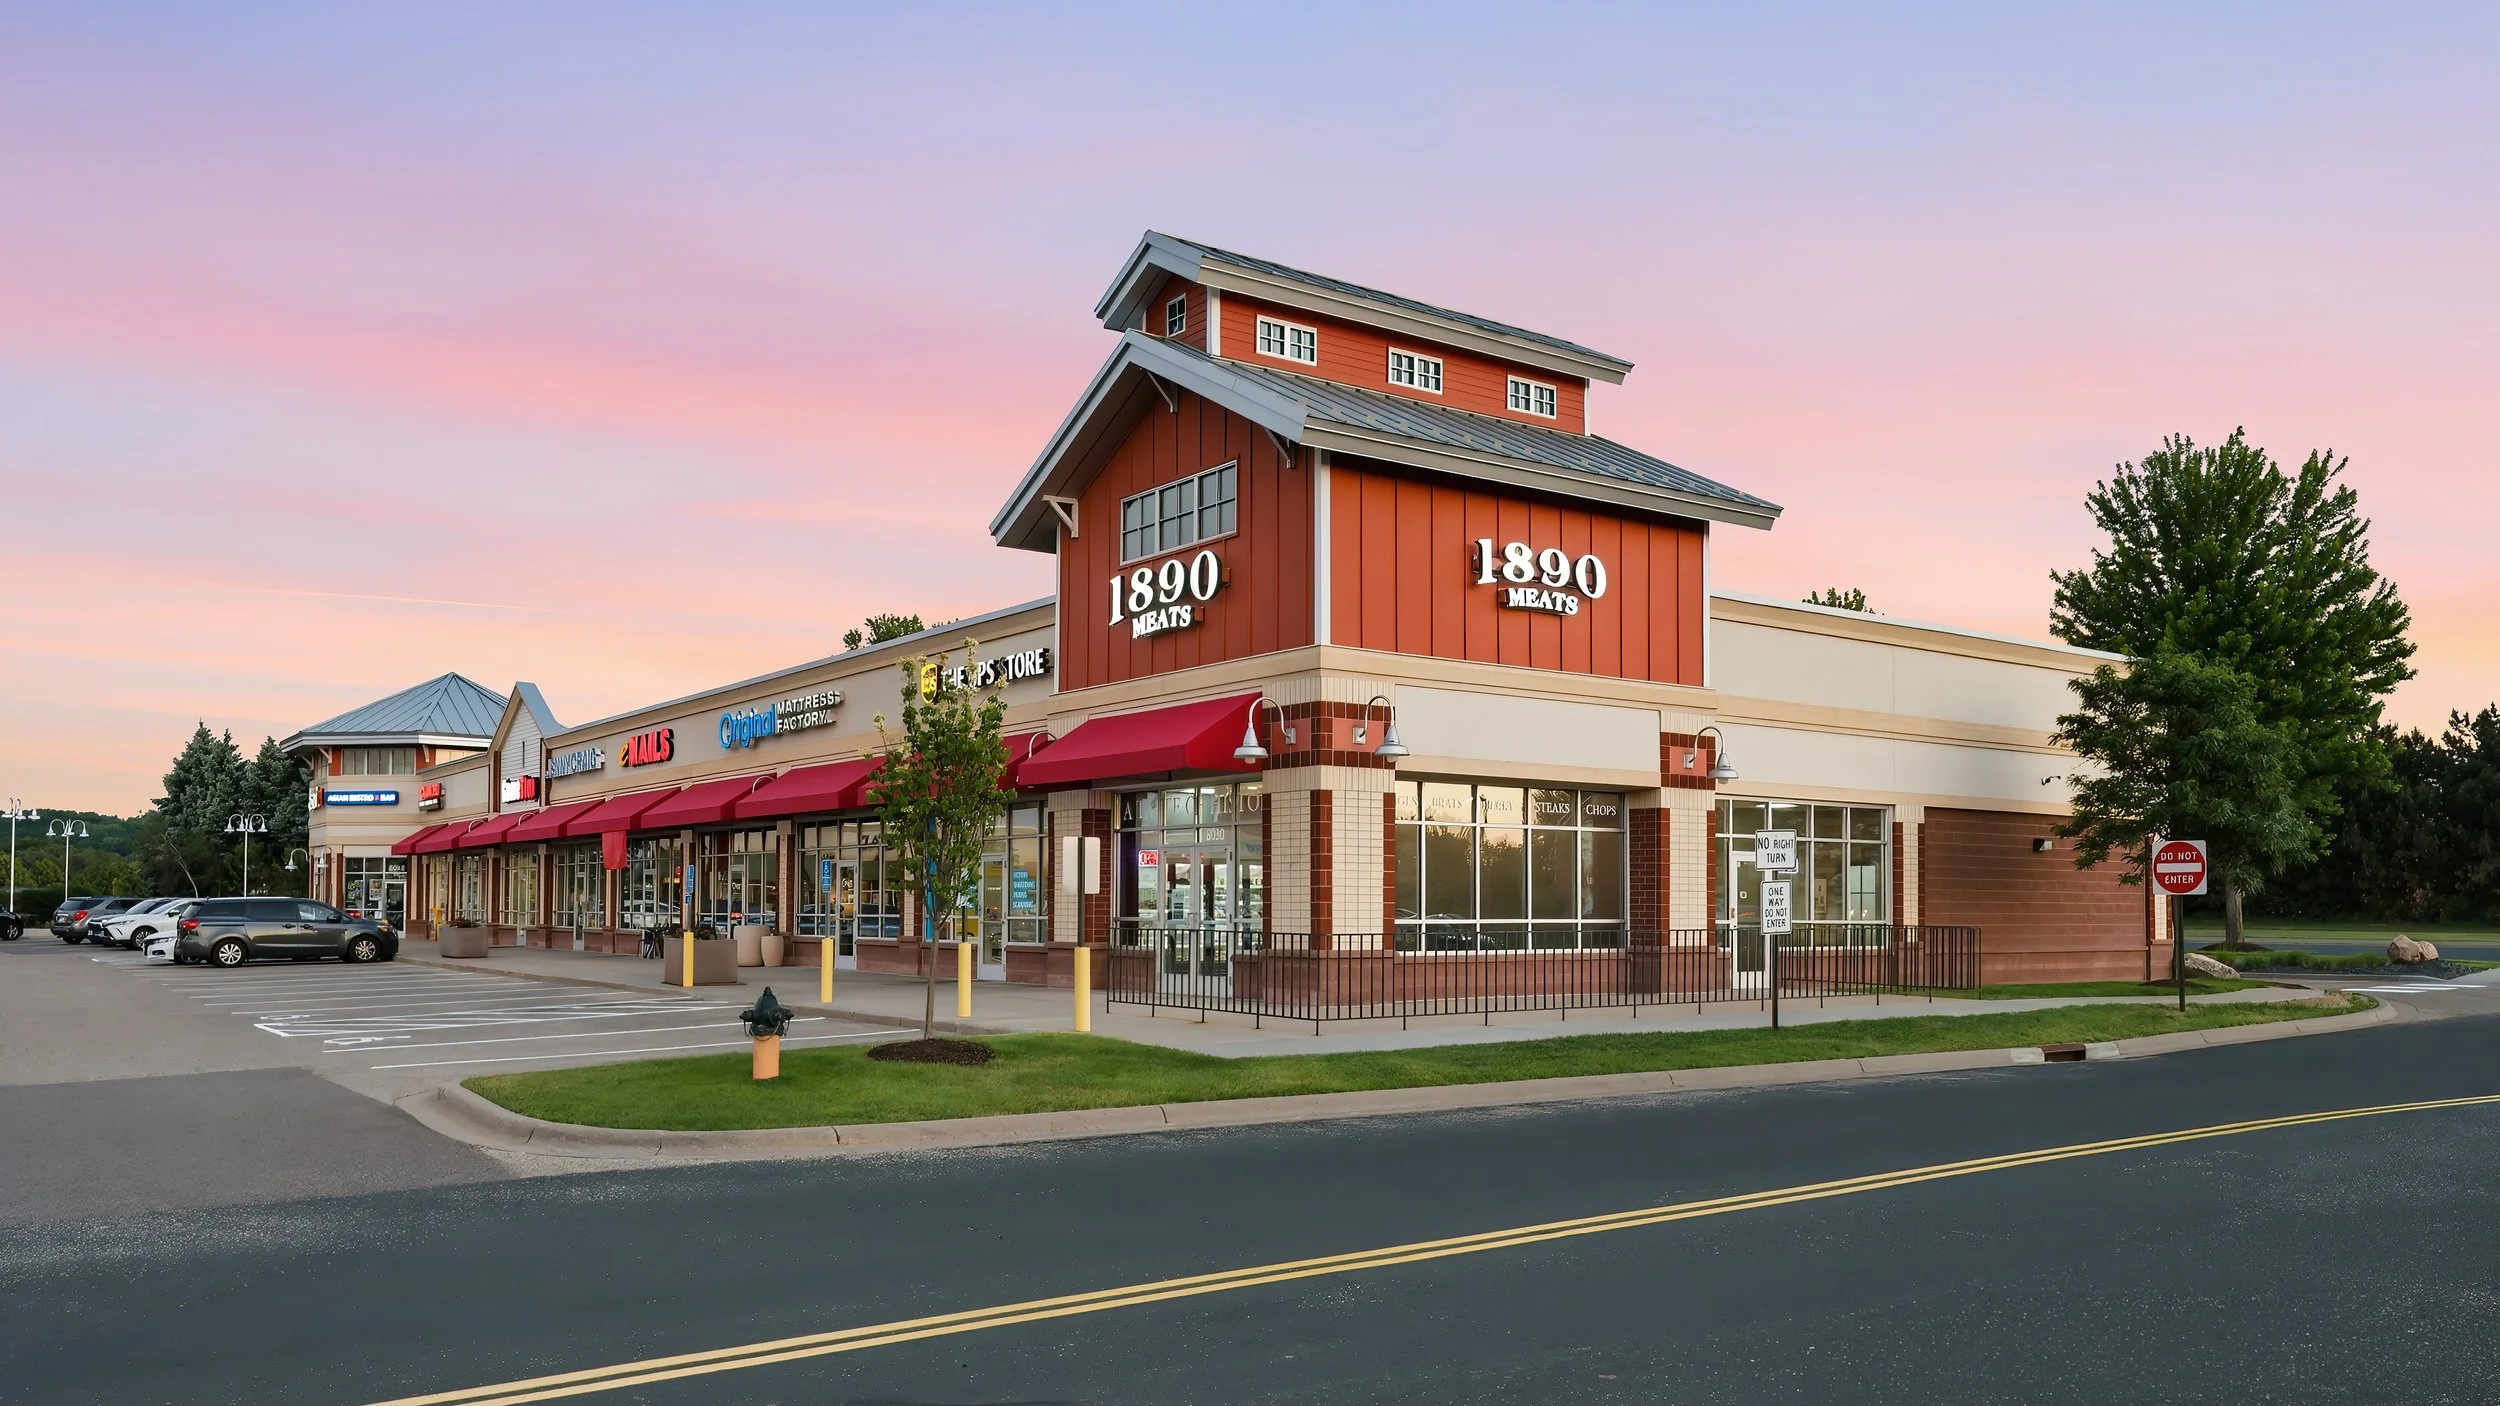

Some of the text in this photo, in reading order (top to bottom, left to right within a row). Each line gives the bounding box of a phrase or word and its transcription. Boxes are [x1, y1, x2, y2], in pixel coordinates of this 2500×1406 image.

[1477, 538, 1607, 599] 1890
[1108, 550, 1219, 627] 1890
[1508, 587, 1579, 616] MEATS
[1132, 604, 1192, 639] MEATS
[777, 690, 835, 715] MATTRESS
[718, 703, 776, 749] Original
[1535, 801, 1570, 814] STEAKS
[1586, 804, 1617, 816] CHOPS
[1757, 837, 1794, 850] NO RIGHT
[1766, 852, 1786, 863] TURN
[2160, 851, 2197, 860] DO NOT
[2165, 875, 2194, 884] ENTER
[1768, 886, 1784, 897] ONE
[1768, 898, 1784, 907] WAY
[1765, 907, 1787, 918] DO NOT
[1766, 918, 1786, 928] ENTER
